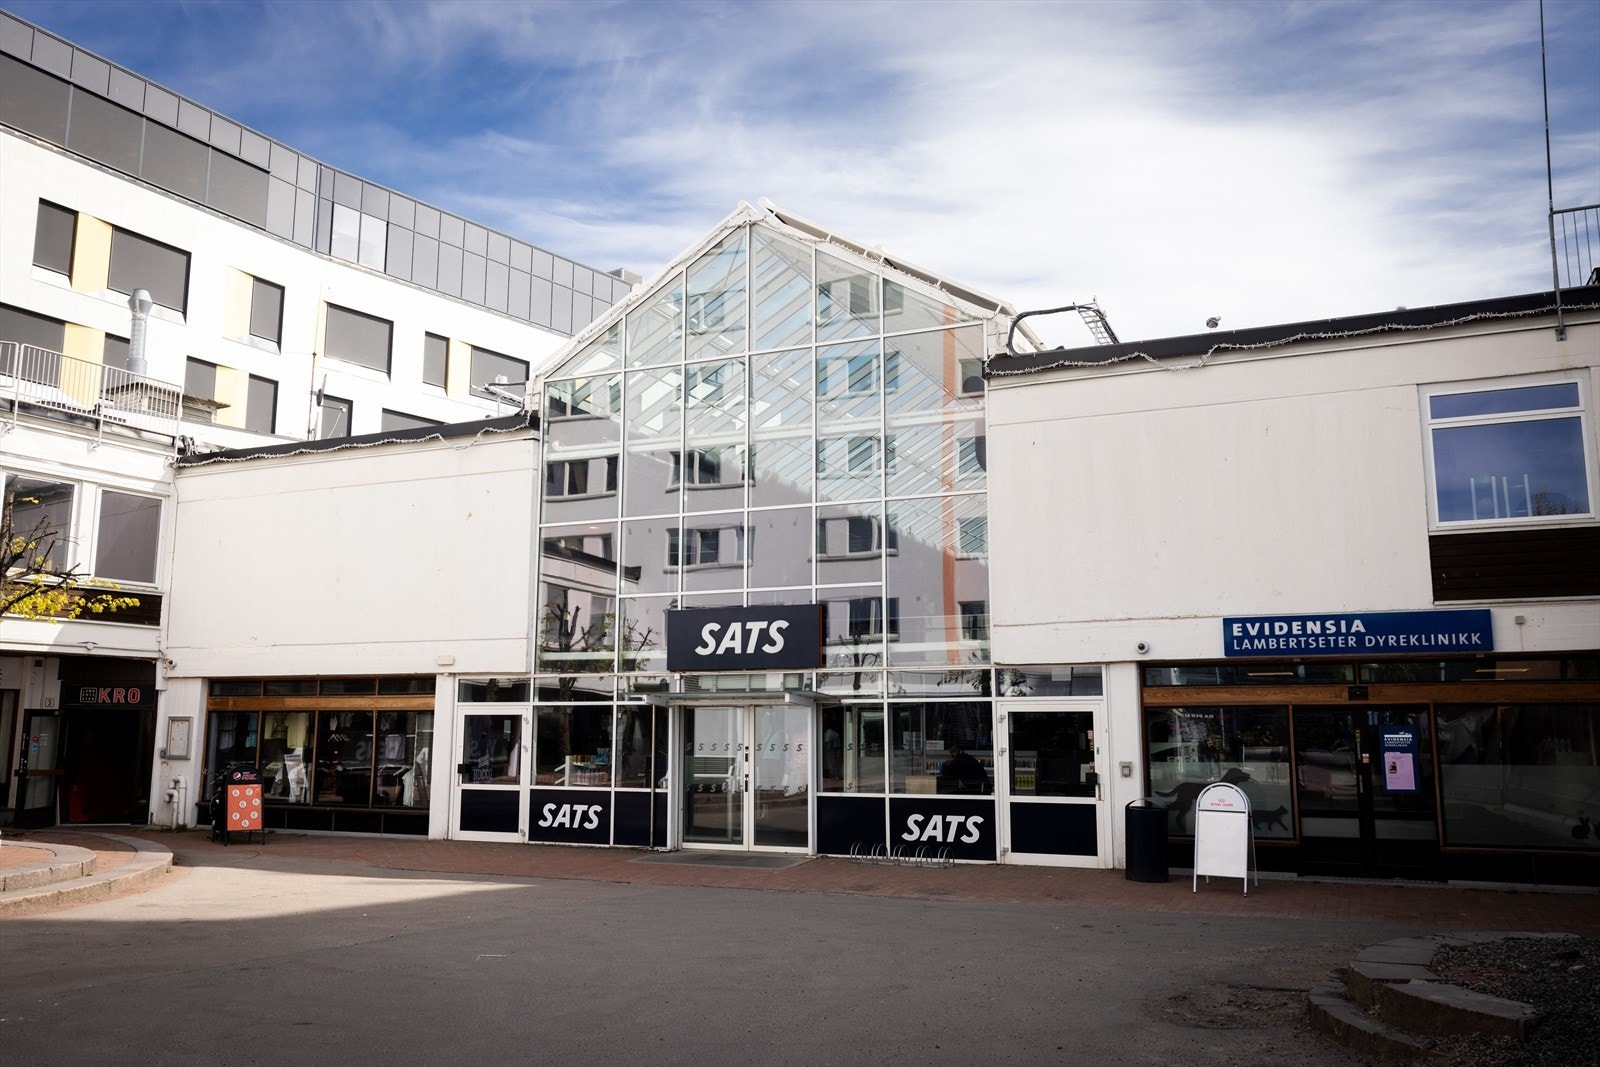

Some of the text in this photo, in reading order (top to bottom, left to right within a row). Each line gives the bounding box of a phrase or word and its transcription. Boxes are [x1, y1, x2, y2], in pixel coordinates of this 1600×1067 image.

[1232, 619, 1367, 637] EVIDENSIA
[694, 619, 790, 656] SATS
[1233, 632, 1482, 650] LAMBERTSETER DYREKLINIKK
[98, 687, 141, 704] KRO
[698, 743, 704, 751] S
[711, 743, 717, 751] S
[724, 743, 730, 751] S
[737, 743, 743, 751] S
[697, 784, 703, 792] S
[710, 784, 716, 792] S
[537, 802, 603, 830] SATS
[901, 813, 984, 844] SATS
